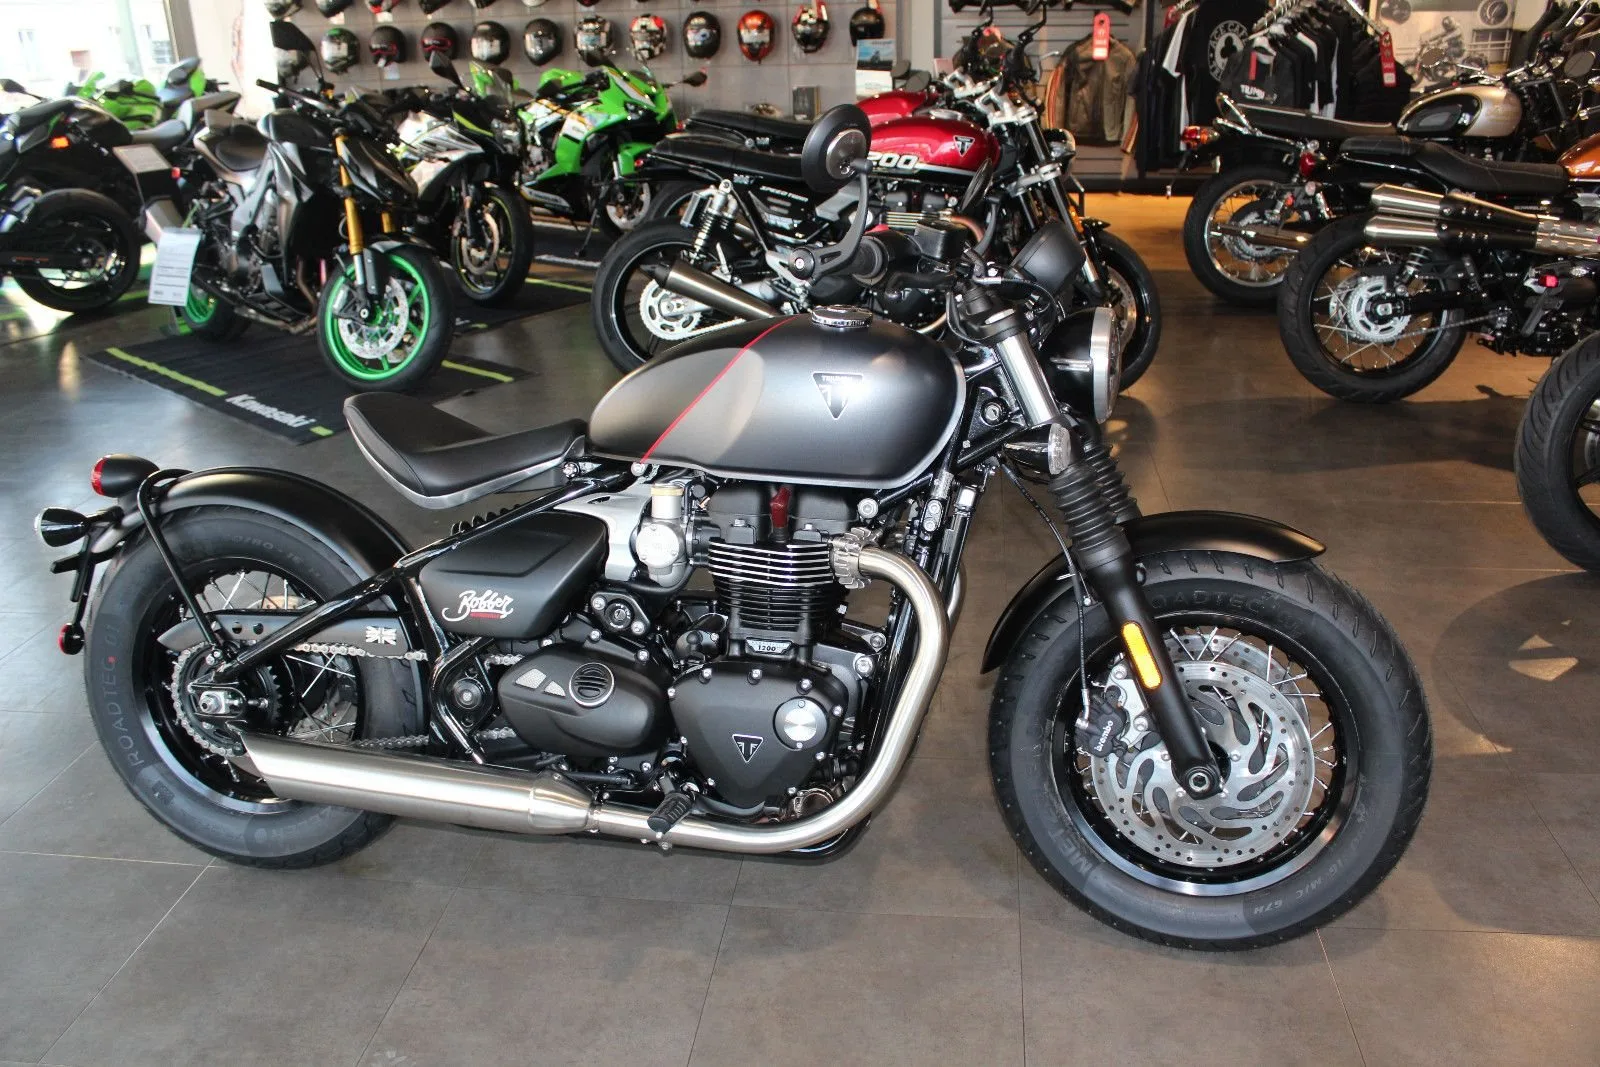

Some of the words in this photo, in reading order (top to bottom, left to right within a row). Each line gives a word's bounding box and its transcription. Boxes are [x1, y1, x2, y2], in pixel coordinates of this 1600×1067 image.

[225, 394, 317, 428] Kawasaki
[441, 590, 514, 622] Bobber
[1094, 720, 1114, 752] brembo
